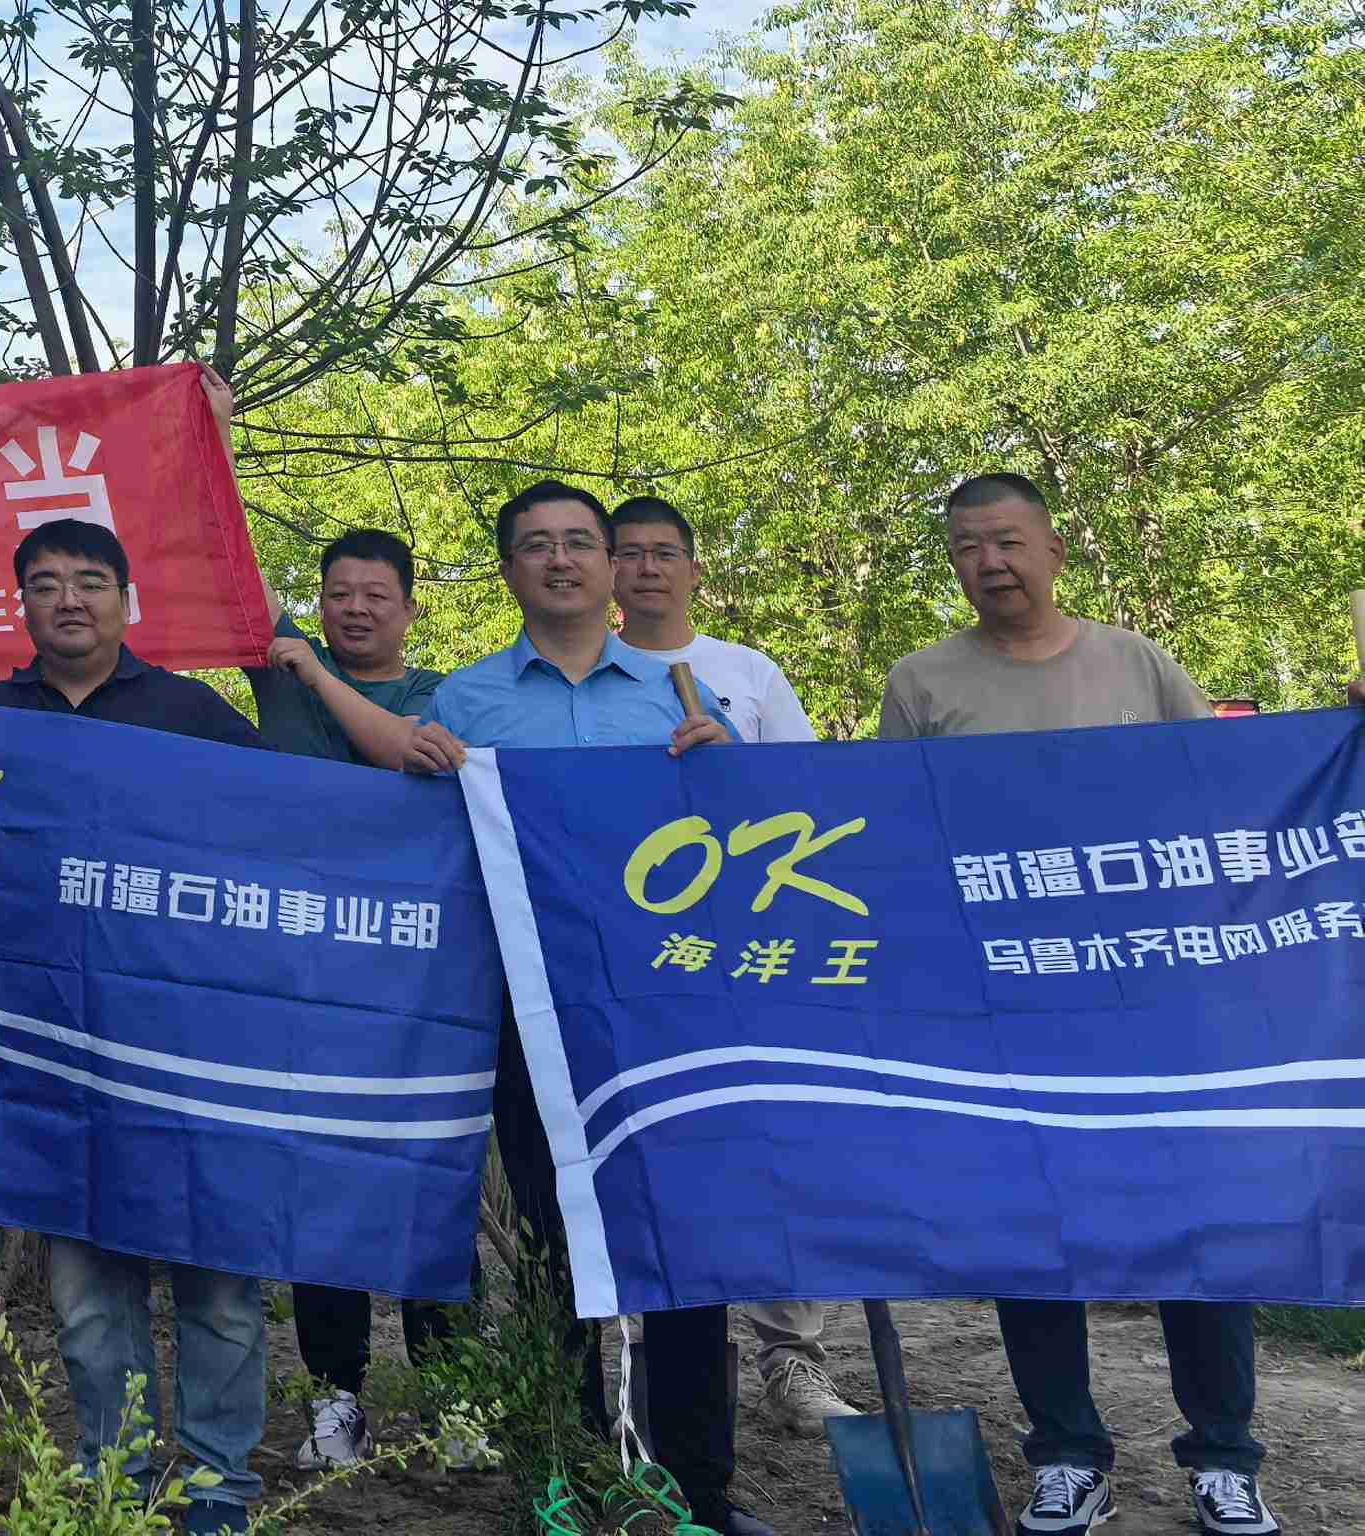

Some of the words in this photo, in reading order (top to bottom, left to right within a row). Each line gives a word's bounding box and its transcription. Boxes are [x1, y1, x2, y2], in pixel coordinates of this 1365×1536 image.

[623, 811, 870, 917] OK
[951, 808, 1365, 903] 新疆石油事业部
[58, 856, 440, 950] 新疆石油事业部
[982, 901, 1365, 976] 乌鲁木齐电网服务
[652, 932, 879, 986] 海洋王
